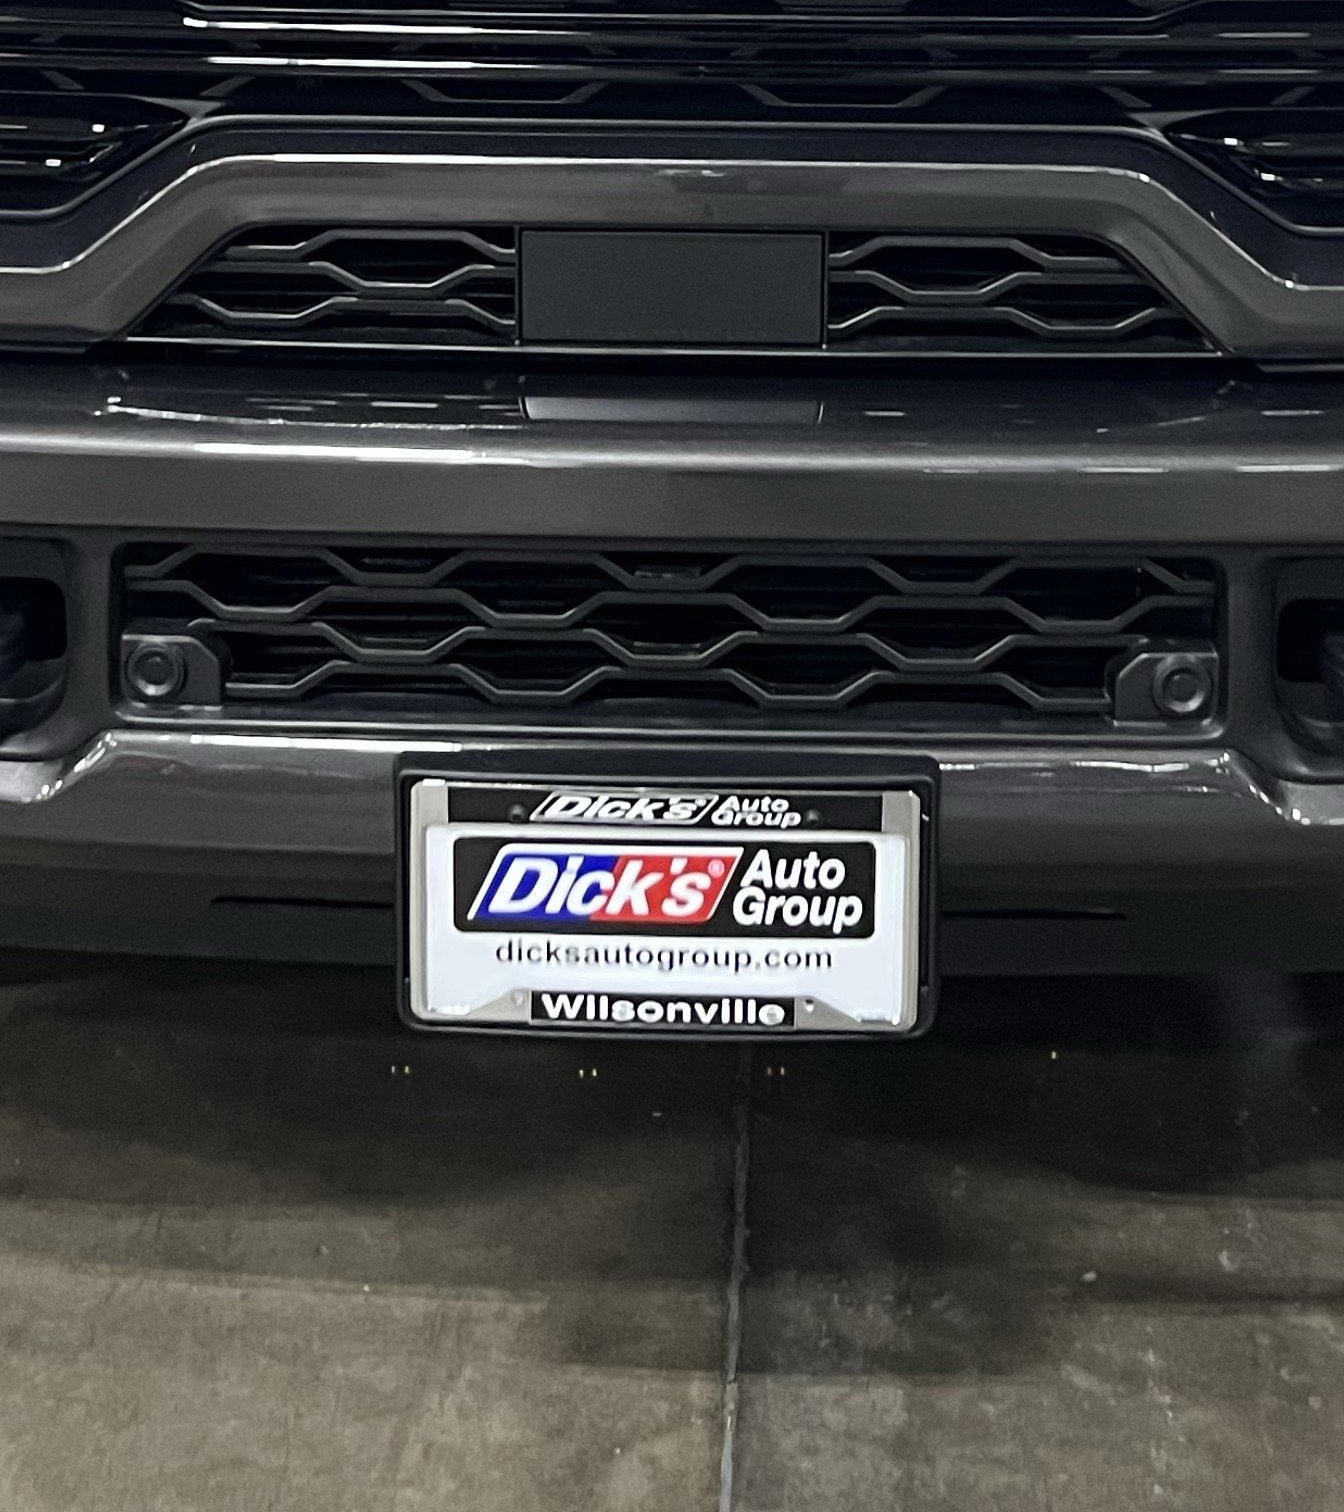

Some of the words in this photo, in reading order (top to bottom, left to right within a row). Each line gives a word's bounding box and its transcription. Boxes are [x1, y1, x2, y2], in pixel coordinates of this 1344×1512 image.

[543, 795, 698, 822] Dick's
[719, 794, 790, 813] Auto
[711, 809, 802, 829] Group
[487, 855, 712, 917] Dick's
[740, 848, 846, 889] Auto
[732, 886, 864, 934] Group
[495, 939, 833, 973] dicksautogroup.com
[541, 992, 785, 1026] Wilsonville
